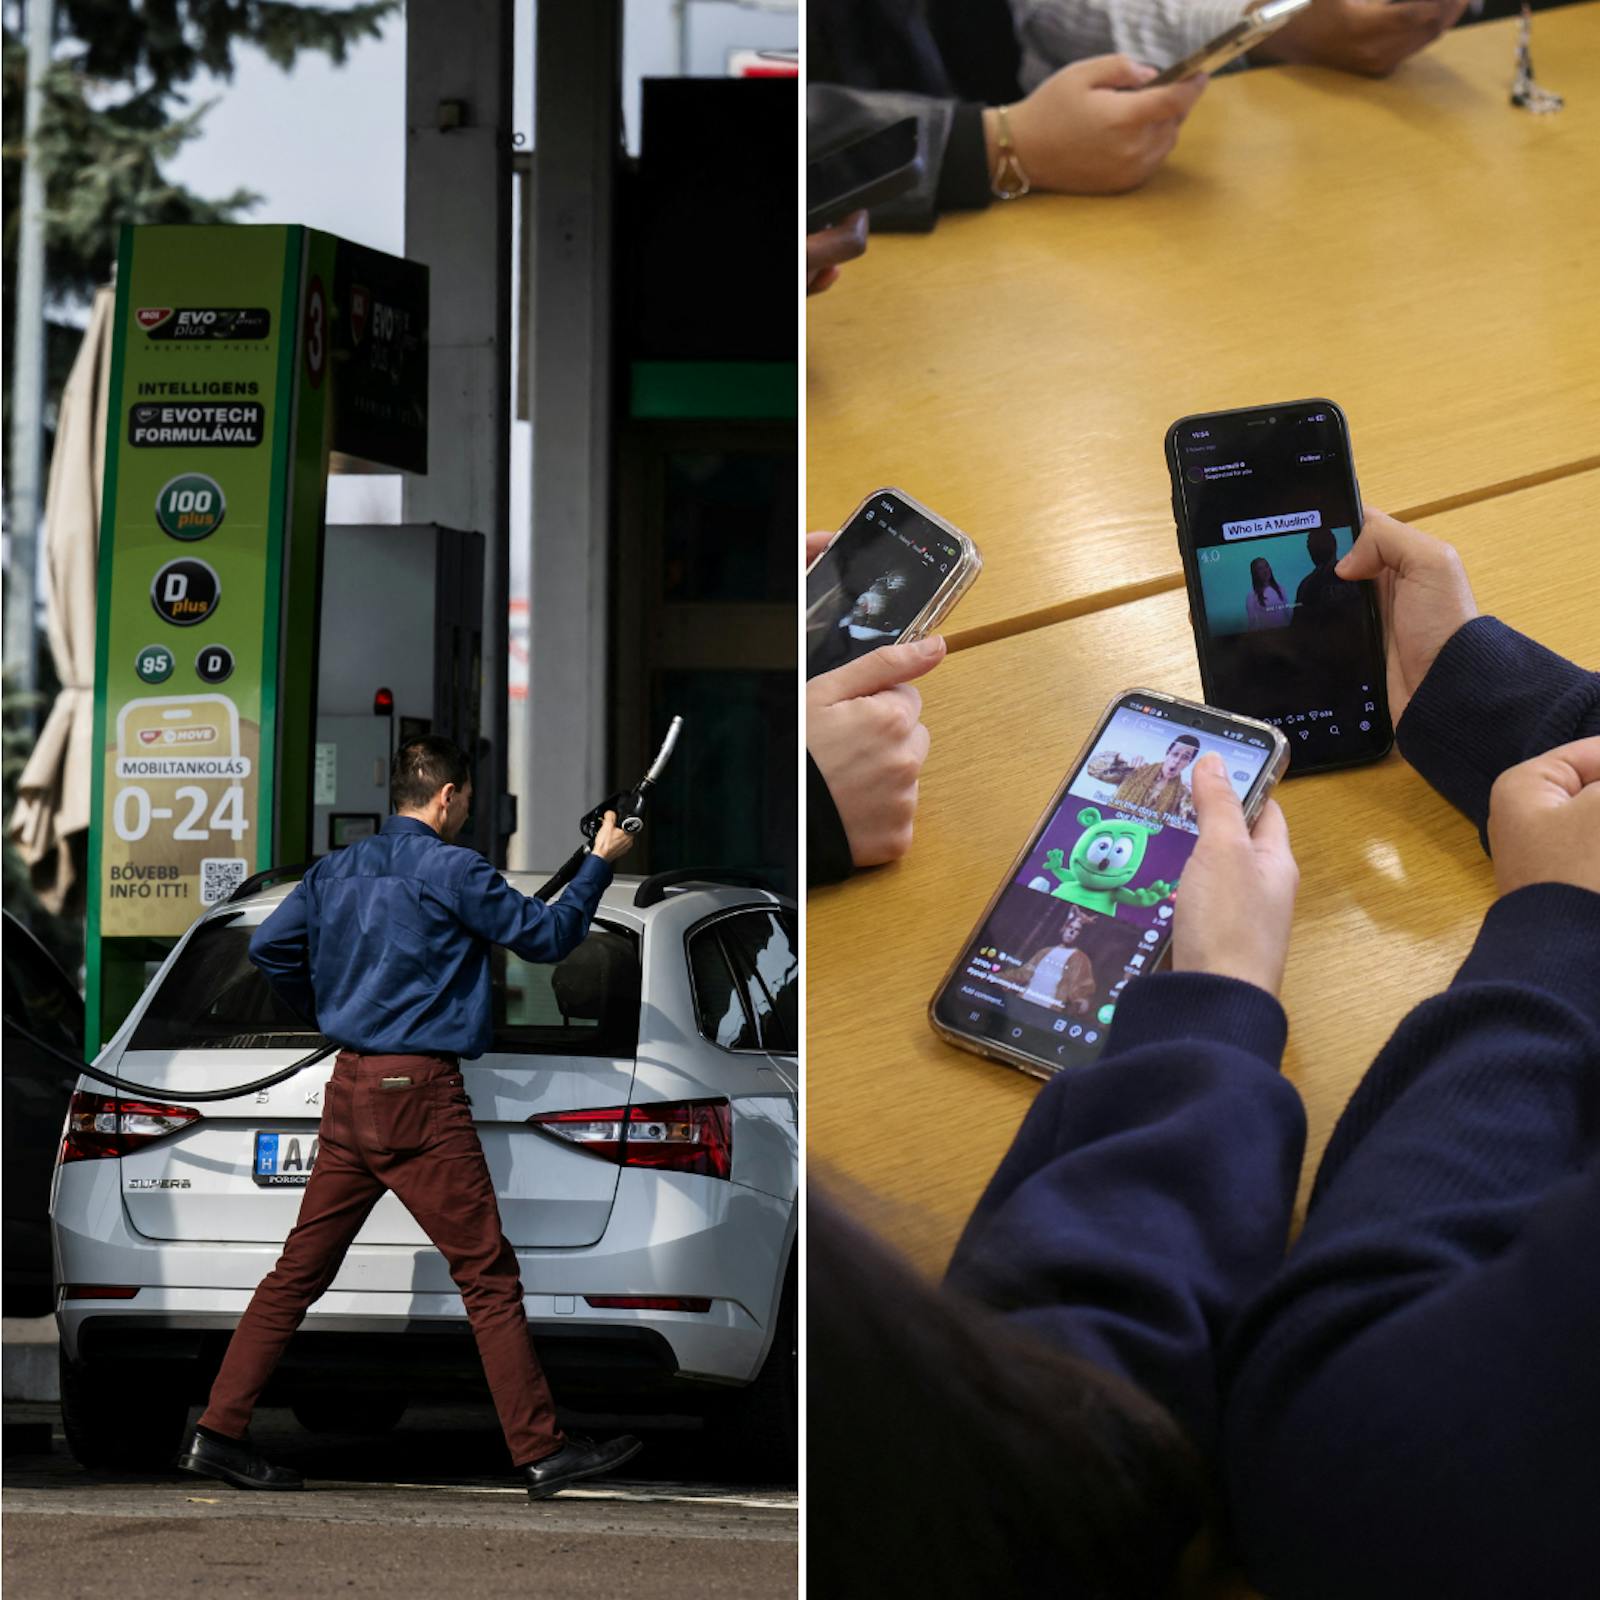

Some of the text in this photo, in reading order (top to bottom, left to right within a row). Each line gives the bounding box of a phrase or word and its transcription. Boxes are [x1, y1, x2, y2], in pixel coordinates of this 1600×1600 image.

[178, 311, 216, 325] EVO
[174, 325, 206, 337] plus
[308, 291, 322, 372] 3
[138, 381, 259, 396] INTELLIGENS
[161, 407, 258, 423] EVOTECH
[135, 424, 257, 442] FORMULÁVAL
[168, 490, 213, 513] 100
[176, 512, 214, 529] plus
[1228, 524, 1252, 536] Who
[1264, 521, 1273, 530] A
[1274, 513, 1315, 529] Muslim?
[163, 573, 188, 603] D
[172, 597, 209, 616] plus
[142, 655, 168, 674] 95
[207, 655, 222, 673] D
[177, 729, 211, 740] MOVE
[122, 759, 244, 775] MOBILTANKOLÁS
[113, 785, 249, 841] 0-24
[110, 862, 180, 881] BŐVEBB
[109, 881, 188, 898] INFÓ ITT!
[261, 1158, 273, 1170] H
[128, 1178, 192, 1189] SUPERB
[268, 1175, 311, 1184] PORSCH
